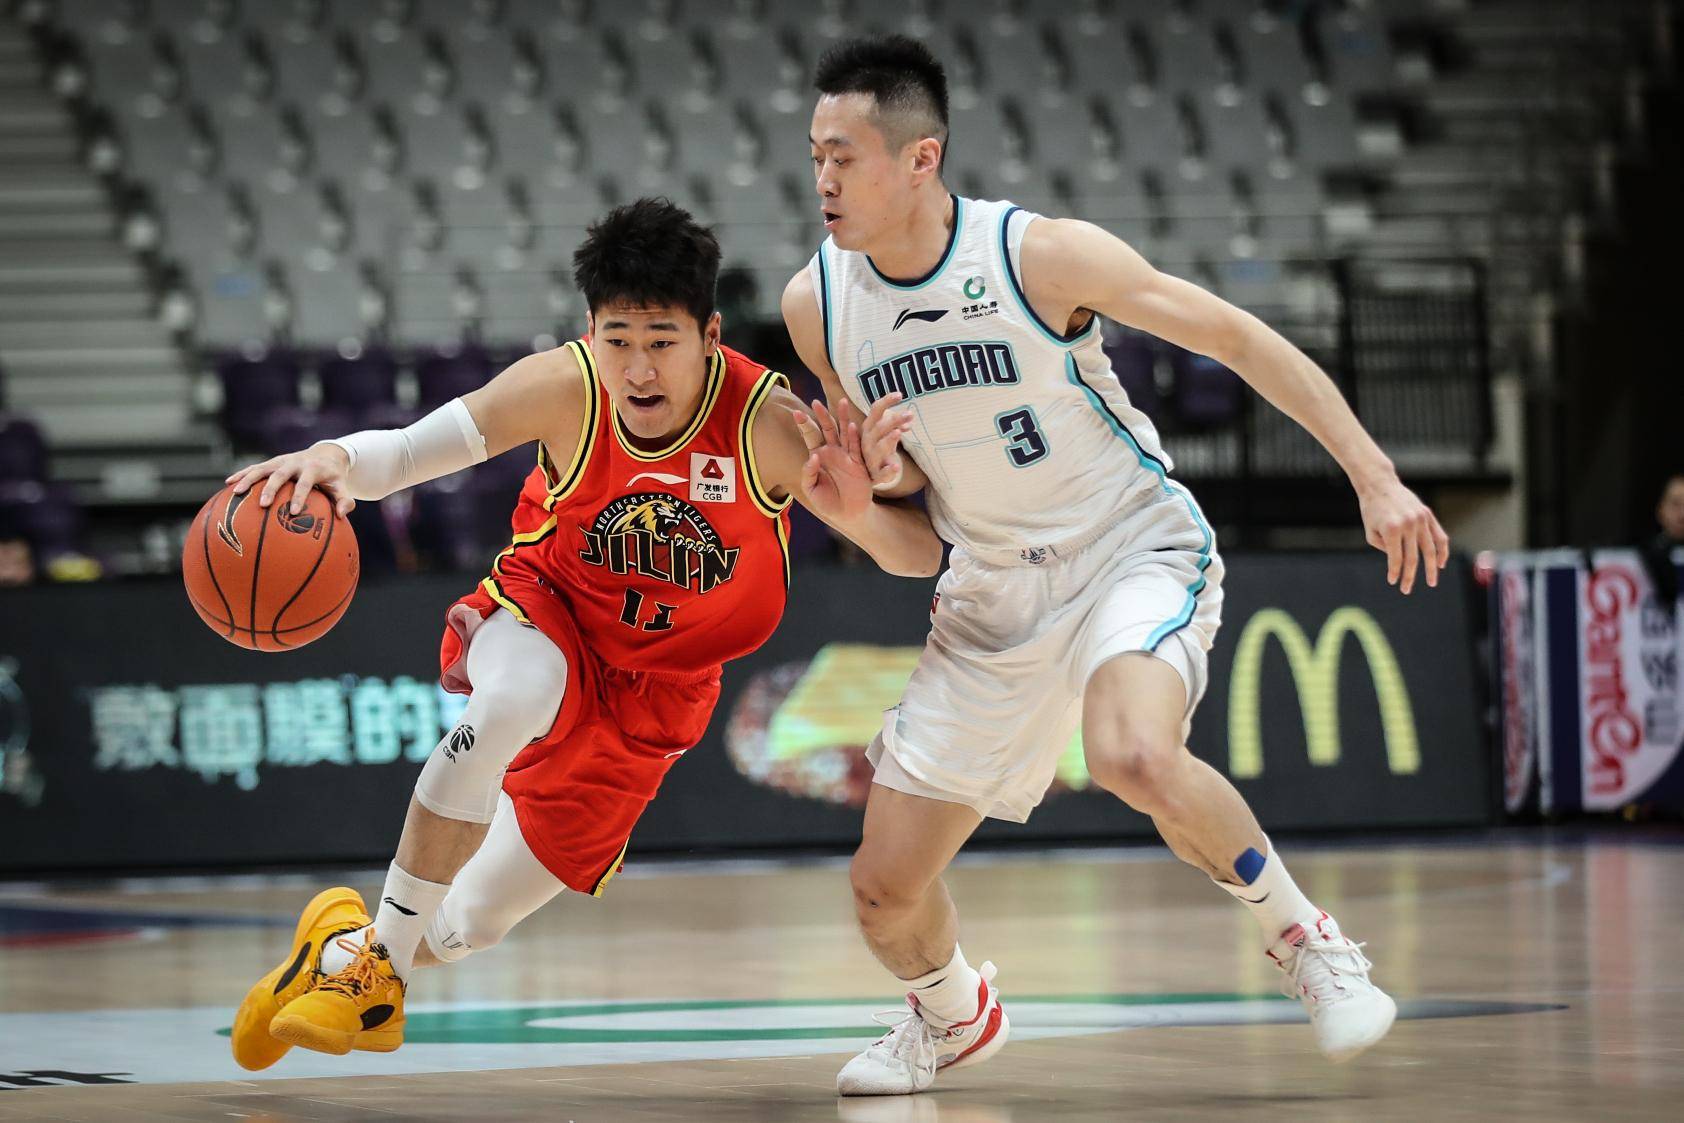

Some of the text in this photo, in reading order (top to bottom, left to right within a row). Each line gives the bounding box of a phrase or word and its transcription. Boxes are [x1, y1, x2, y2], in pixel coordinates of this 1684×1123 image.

[961, 301, 998, 314] 中国人寿
[963, 313, 984, 321] CHINA
[994, 405, 1049, 468] 3
[696, 483, 729, 493] 广发银行
[702, 492, 722, 501] CGB
[595, 494, 717, 541] NORTHEASTERN TIGERS
[578, 526, 740, 595] JILIN
[619, 587, 680, 633] 11
